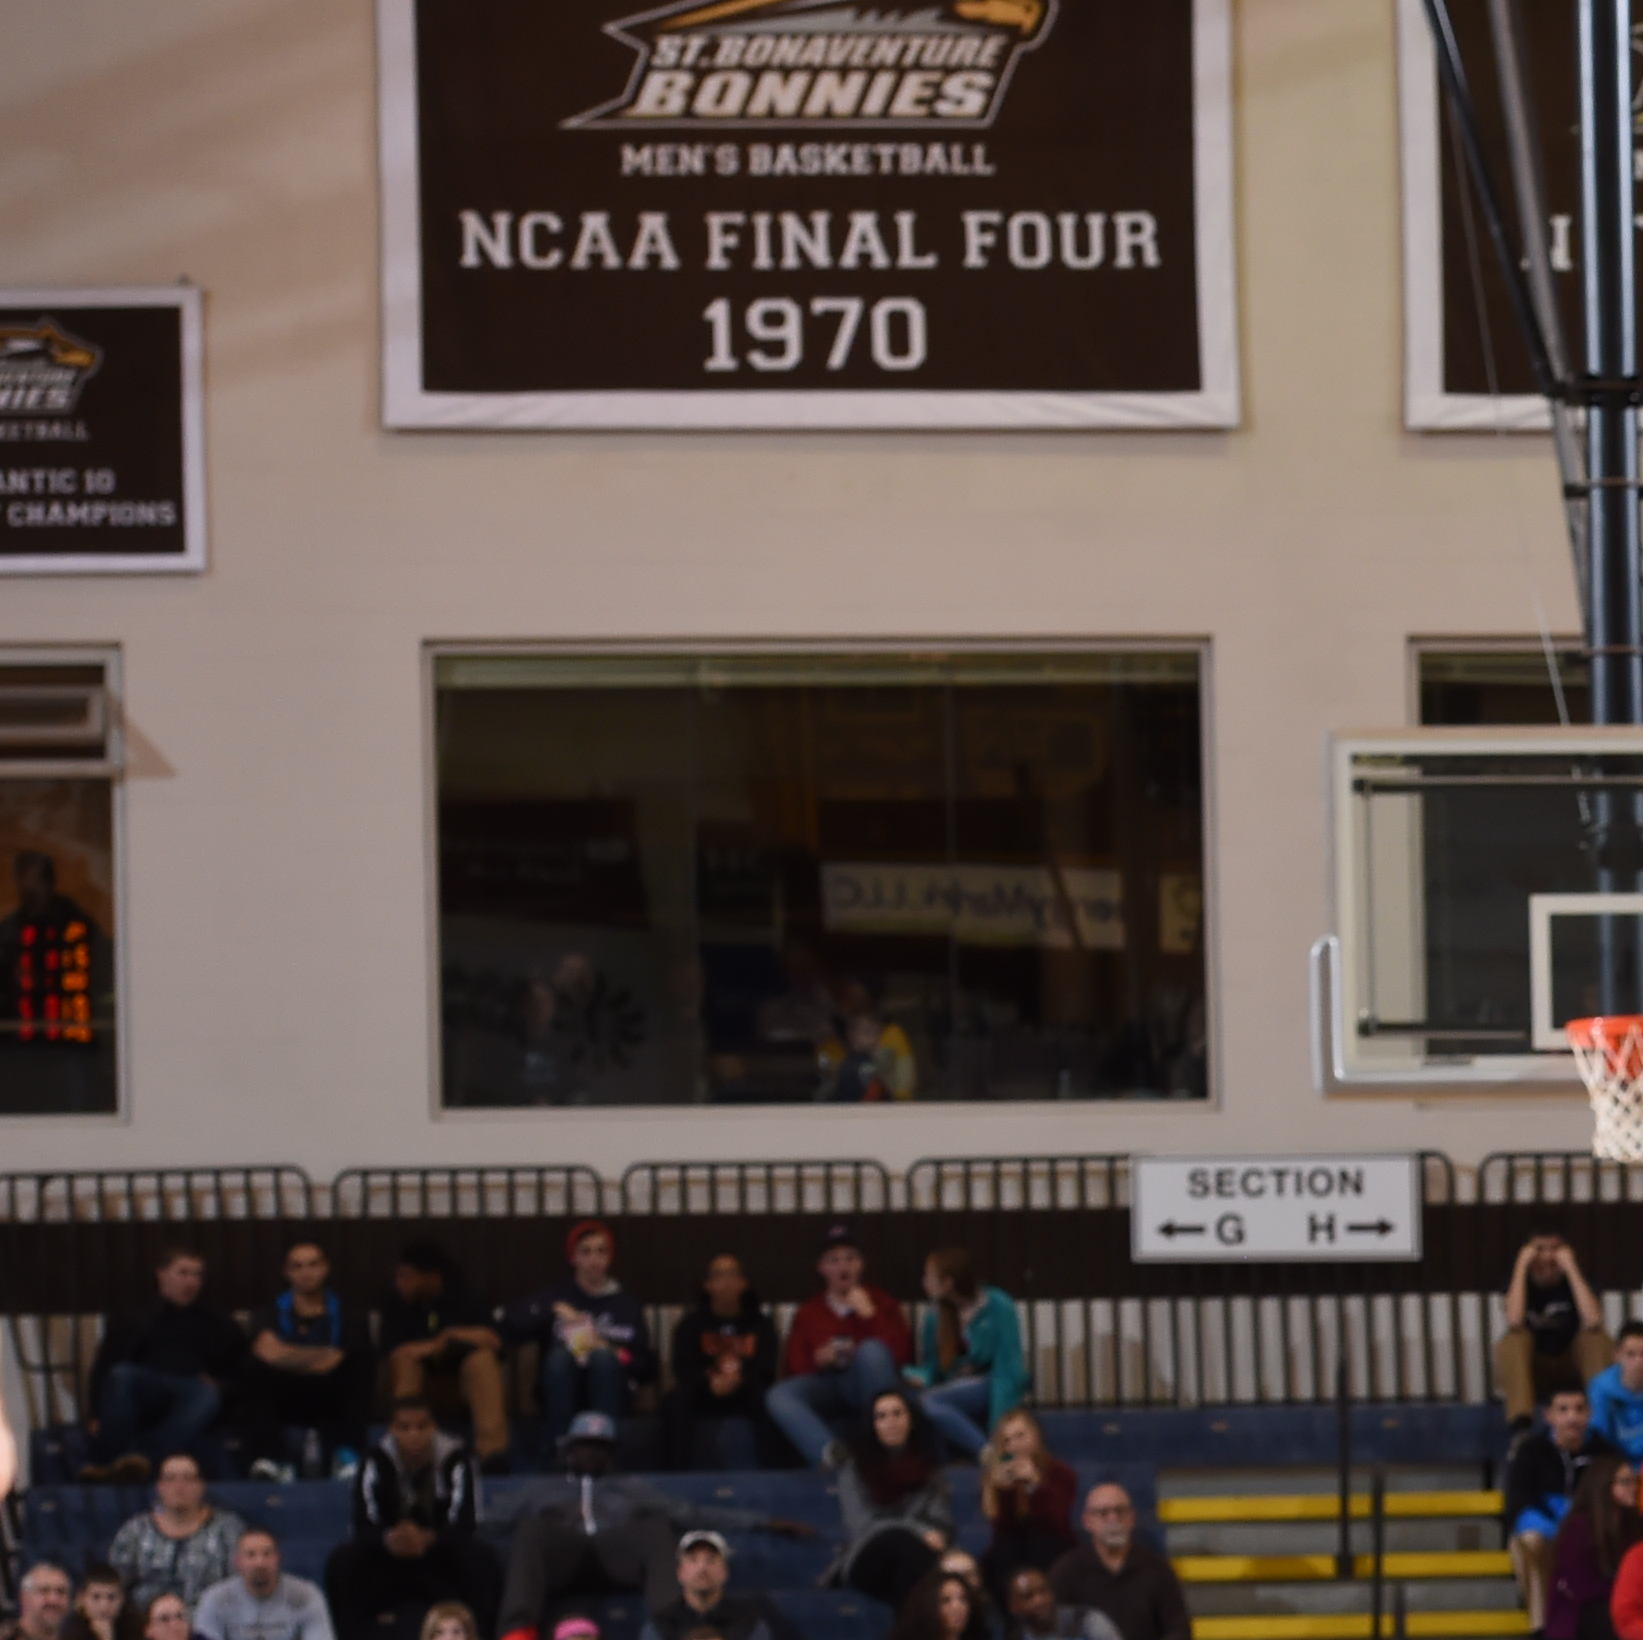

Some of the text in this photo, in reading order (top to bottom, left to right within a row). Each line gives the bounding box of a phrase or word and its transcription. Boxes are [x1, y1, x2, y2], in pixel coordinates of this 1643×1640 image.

[625, 70, 995, 118] BONNIES
[621, 144, 996, 176] MEN'S BASKETBALL
[459, 211, 1162, 270] NCAA FINAL FOUR
[703, 296, 928, 373] 1970
[83, 468, 116, 495] 10
[7, 501, 176, 527] CHAMPIONS
[1186, 1167, 1365, 1199] SECTION
[1215, 1211, 1336, 1246] G H
